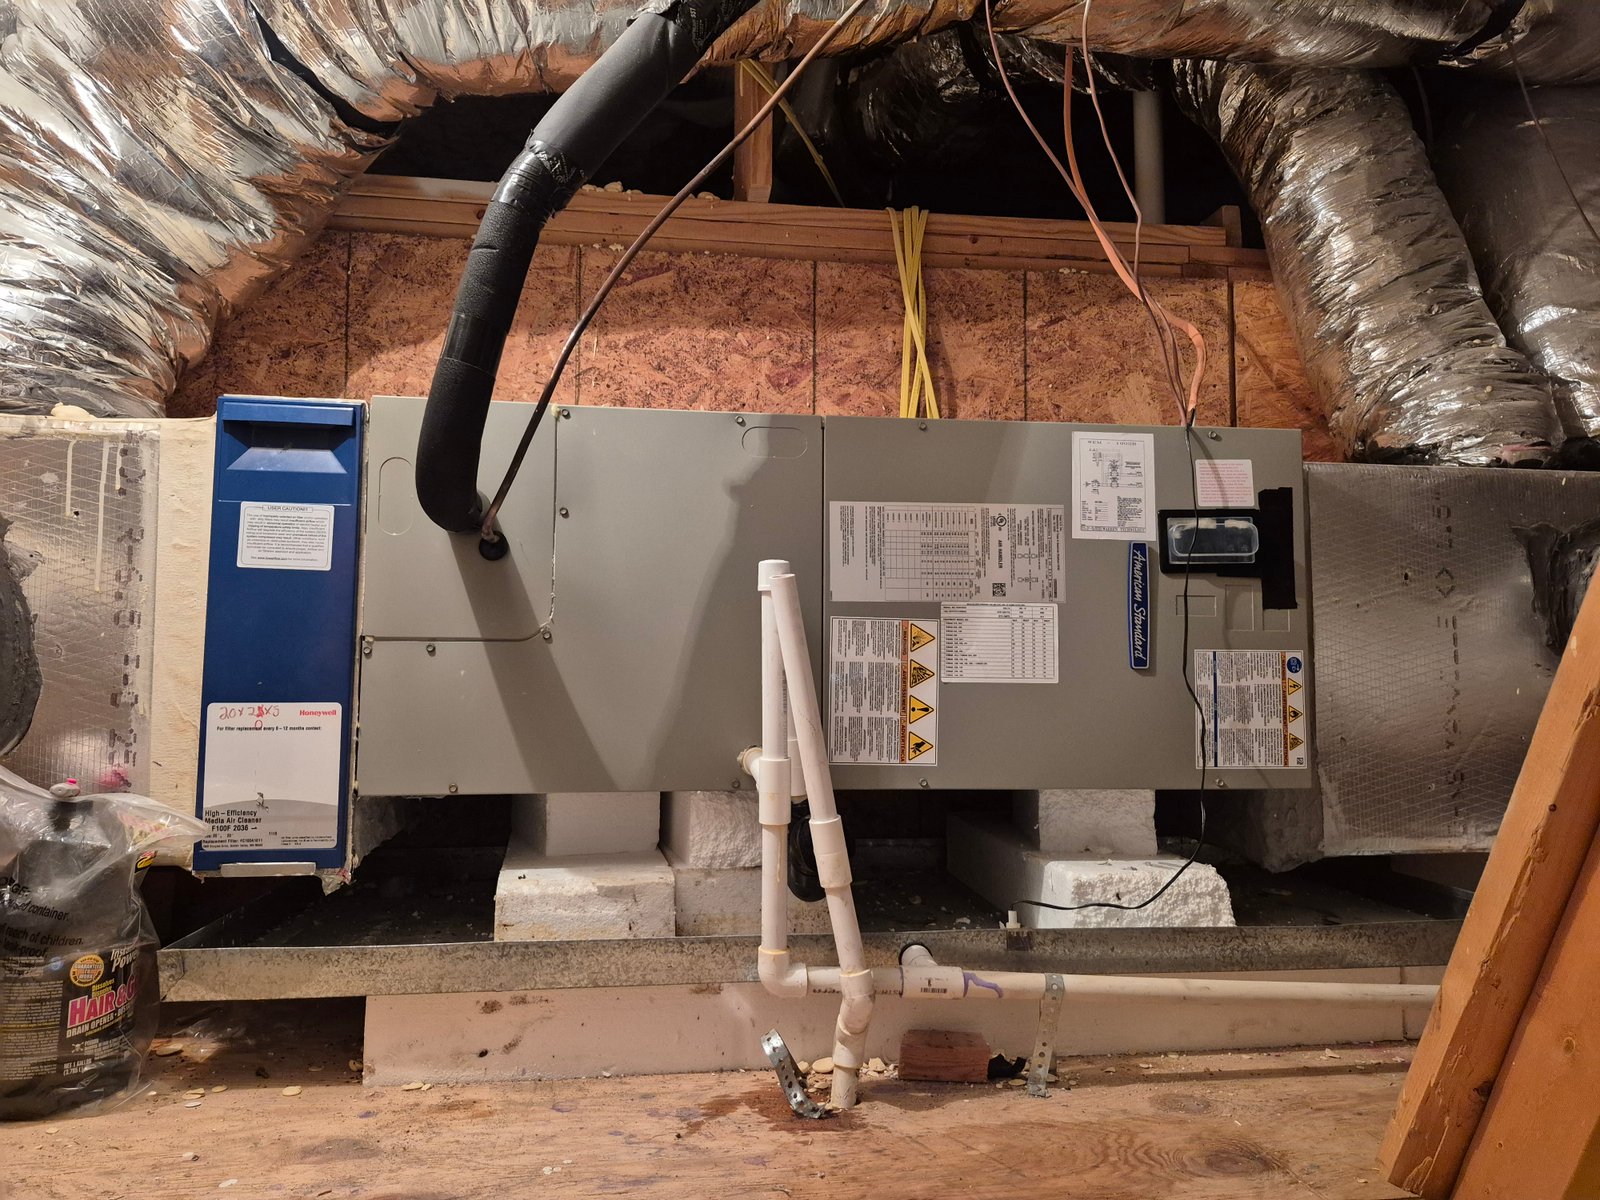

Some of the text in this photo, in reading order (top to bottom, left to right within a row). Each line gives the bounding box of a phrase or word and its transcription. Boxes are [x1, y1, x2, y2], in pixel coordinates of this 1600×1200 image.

[1133, 549, 1147, 661] American Standard
[299, 709, 336, 717] Honeywell
[67, 990, 116, 1029] HAIR
